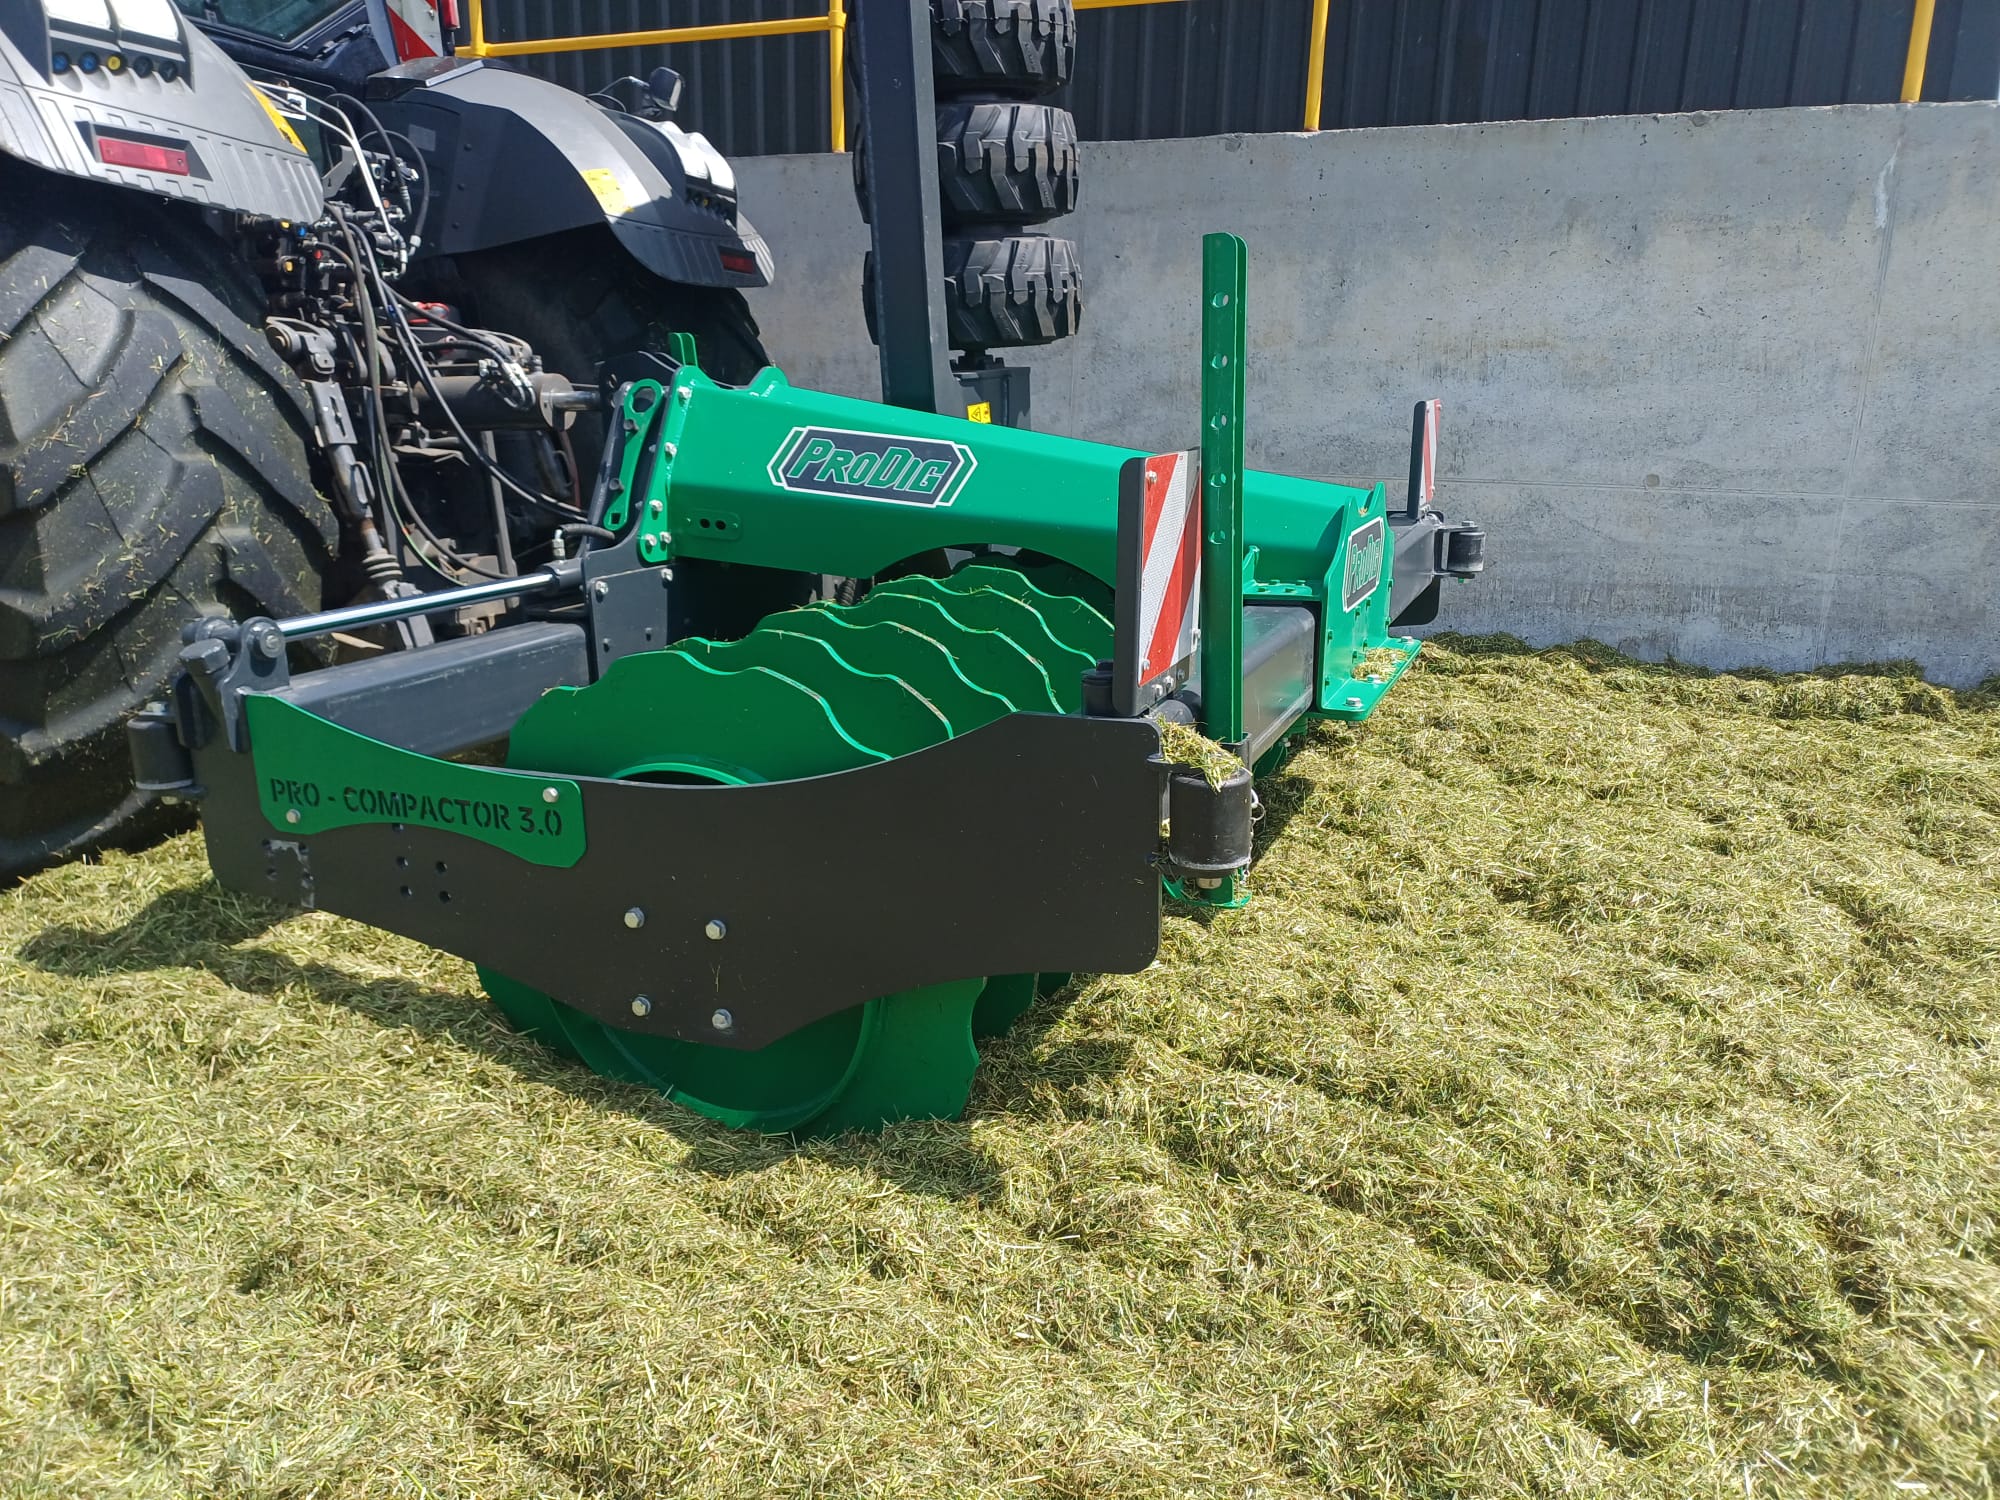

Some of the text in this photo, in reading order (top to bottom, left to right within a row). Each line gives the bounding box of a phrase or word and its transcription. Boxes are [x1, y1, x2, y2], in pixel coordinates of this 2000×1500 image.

[271, 777, 320, 807] PRO
[343, 786, 511, 831] COMPACTOR
[518, 806, 562, 837] 3.0
